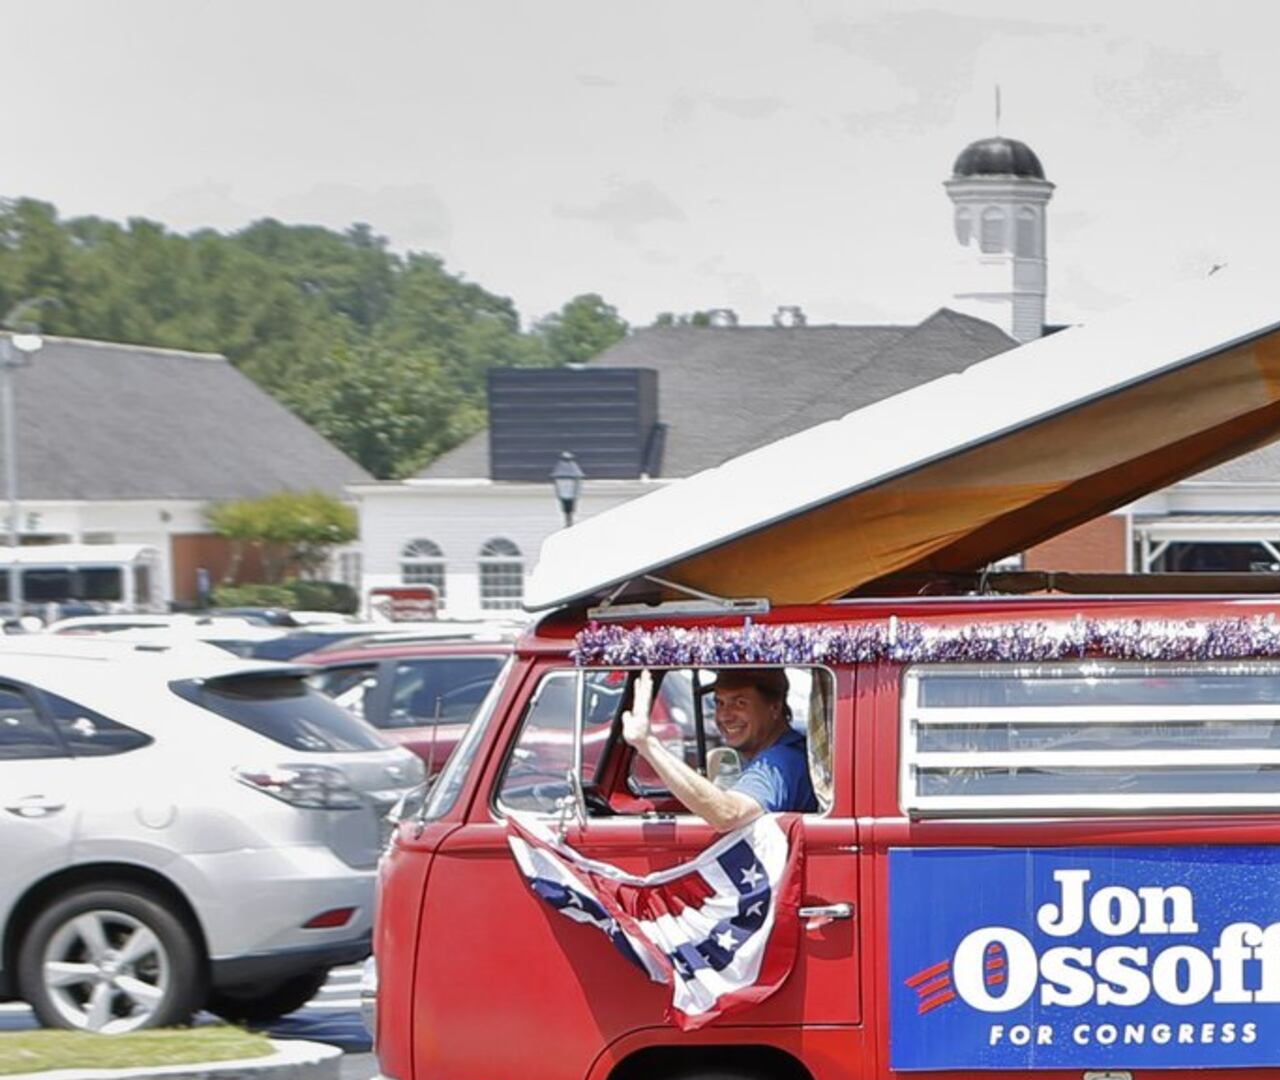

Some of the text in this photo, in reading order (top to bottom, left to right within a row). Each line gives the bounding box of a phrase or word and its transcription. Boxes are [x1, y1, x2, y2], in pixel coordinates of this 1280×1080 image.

[1036, 869, 1199, 937] Jon
[989, 1022, 1258, 1046] FOR CONGRESS
